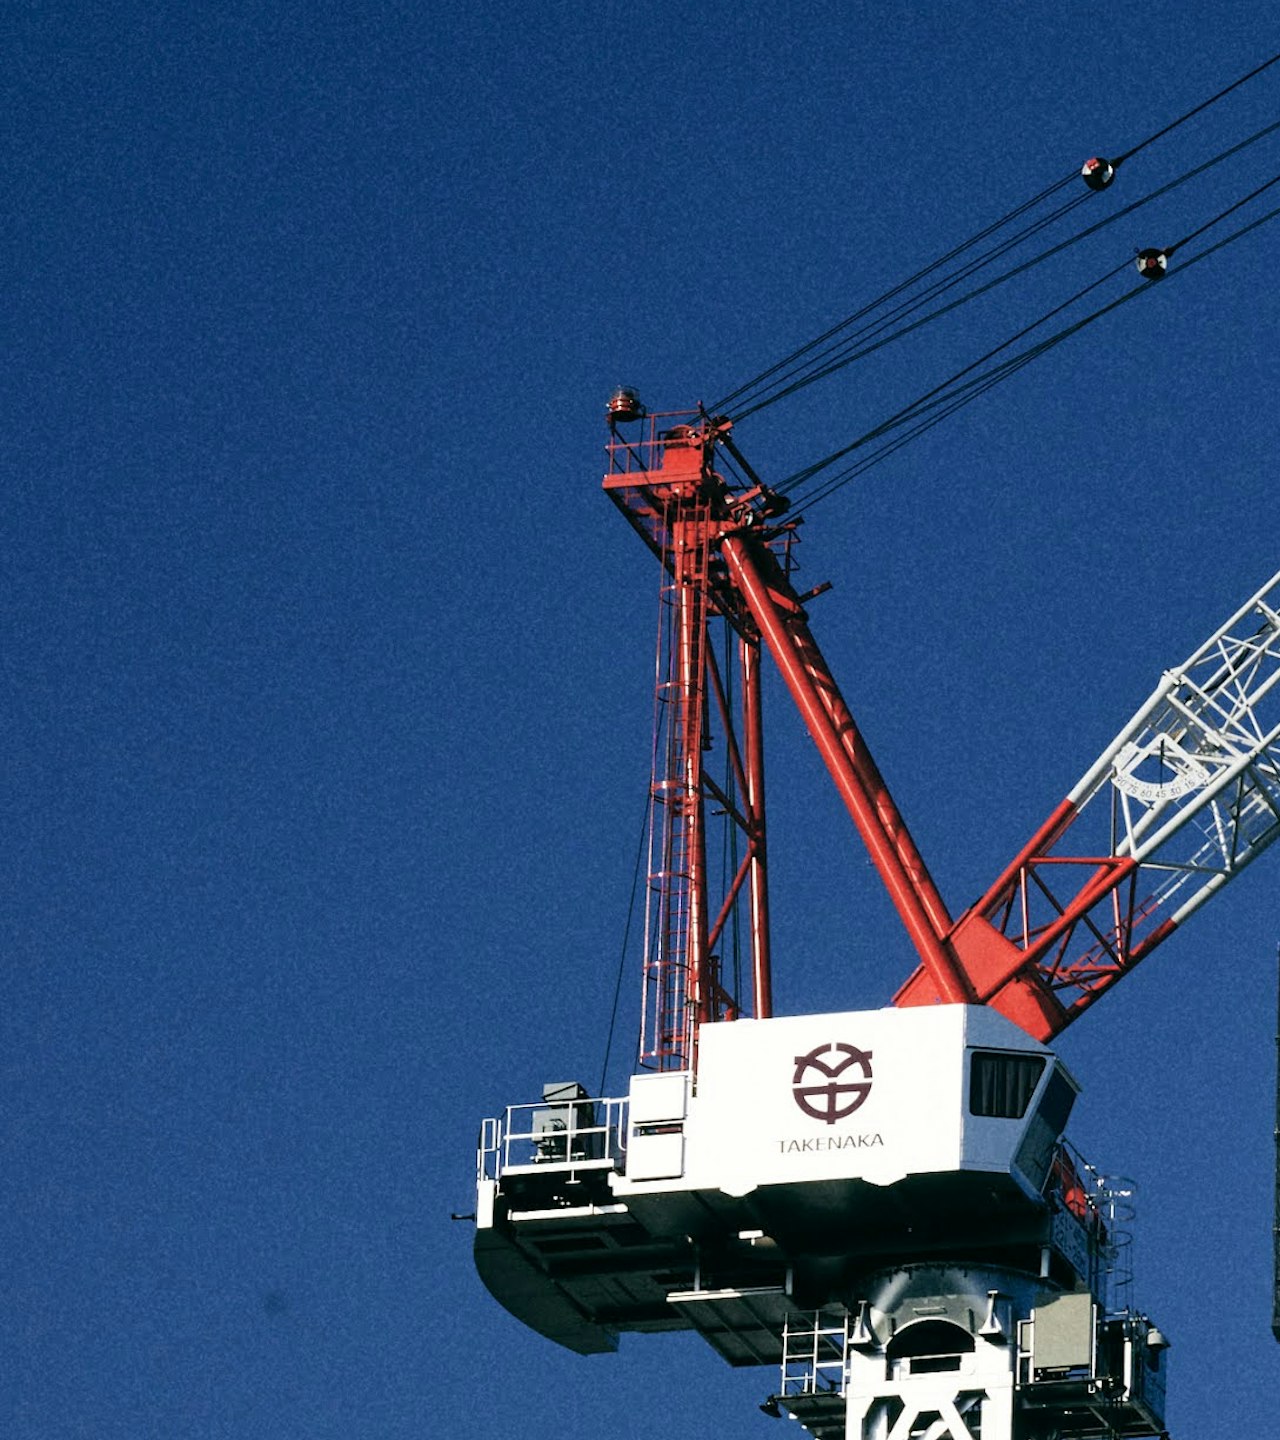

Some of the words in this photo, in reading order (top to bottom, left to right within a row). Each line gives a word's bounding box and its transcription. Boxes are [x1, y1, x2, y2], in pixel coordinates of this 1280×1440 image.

[1127, 784, 1137, 794] 75
[1155, 789, 1166, 798] 45
[1185, 780, 1195, 789] 15
[777, 1133, 884, 1153] TAKENAKA
